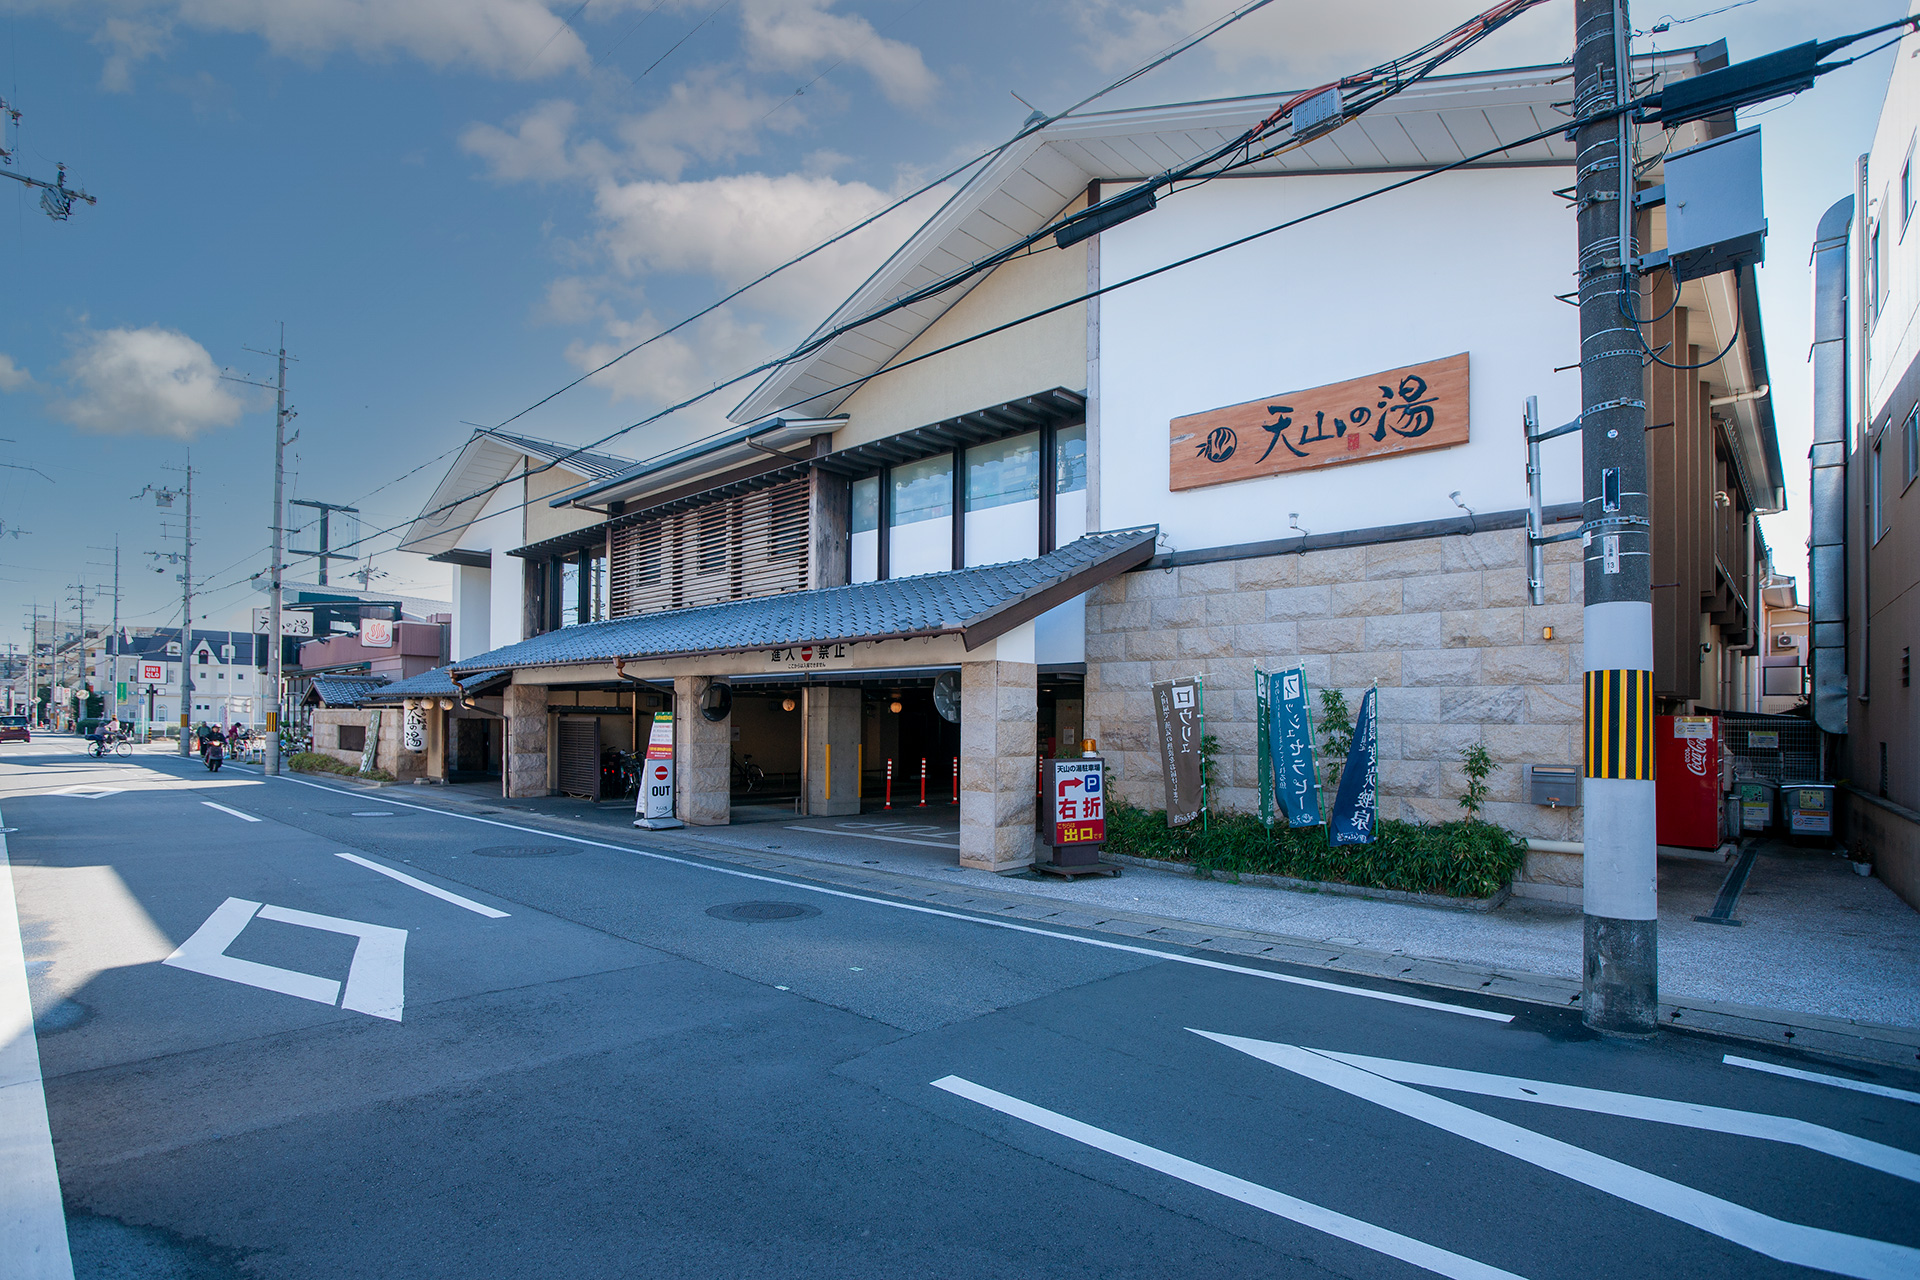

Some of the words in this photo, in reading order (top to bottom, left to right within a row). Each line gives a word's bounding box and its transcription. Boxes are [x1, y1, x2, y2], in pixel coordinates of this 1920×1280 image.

[1255, 374, 1439, 465] 天山の湯
[258, 616, 310, 634] 天の湯
[771, 648, 795, 662] 進入
[818, 644, 845, 659] 禁止
[405, 701, 423, 747] 天山の湯
[1057, 764, 1101, 773] 天山の湯駐車場
[651, 785, 671, 797] OUT
[1087, 777, 1097, 790] P
[1058, 797, 1101, 819] 右折
